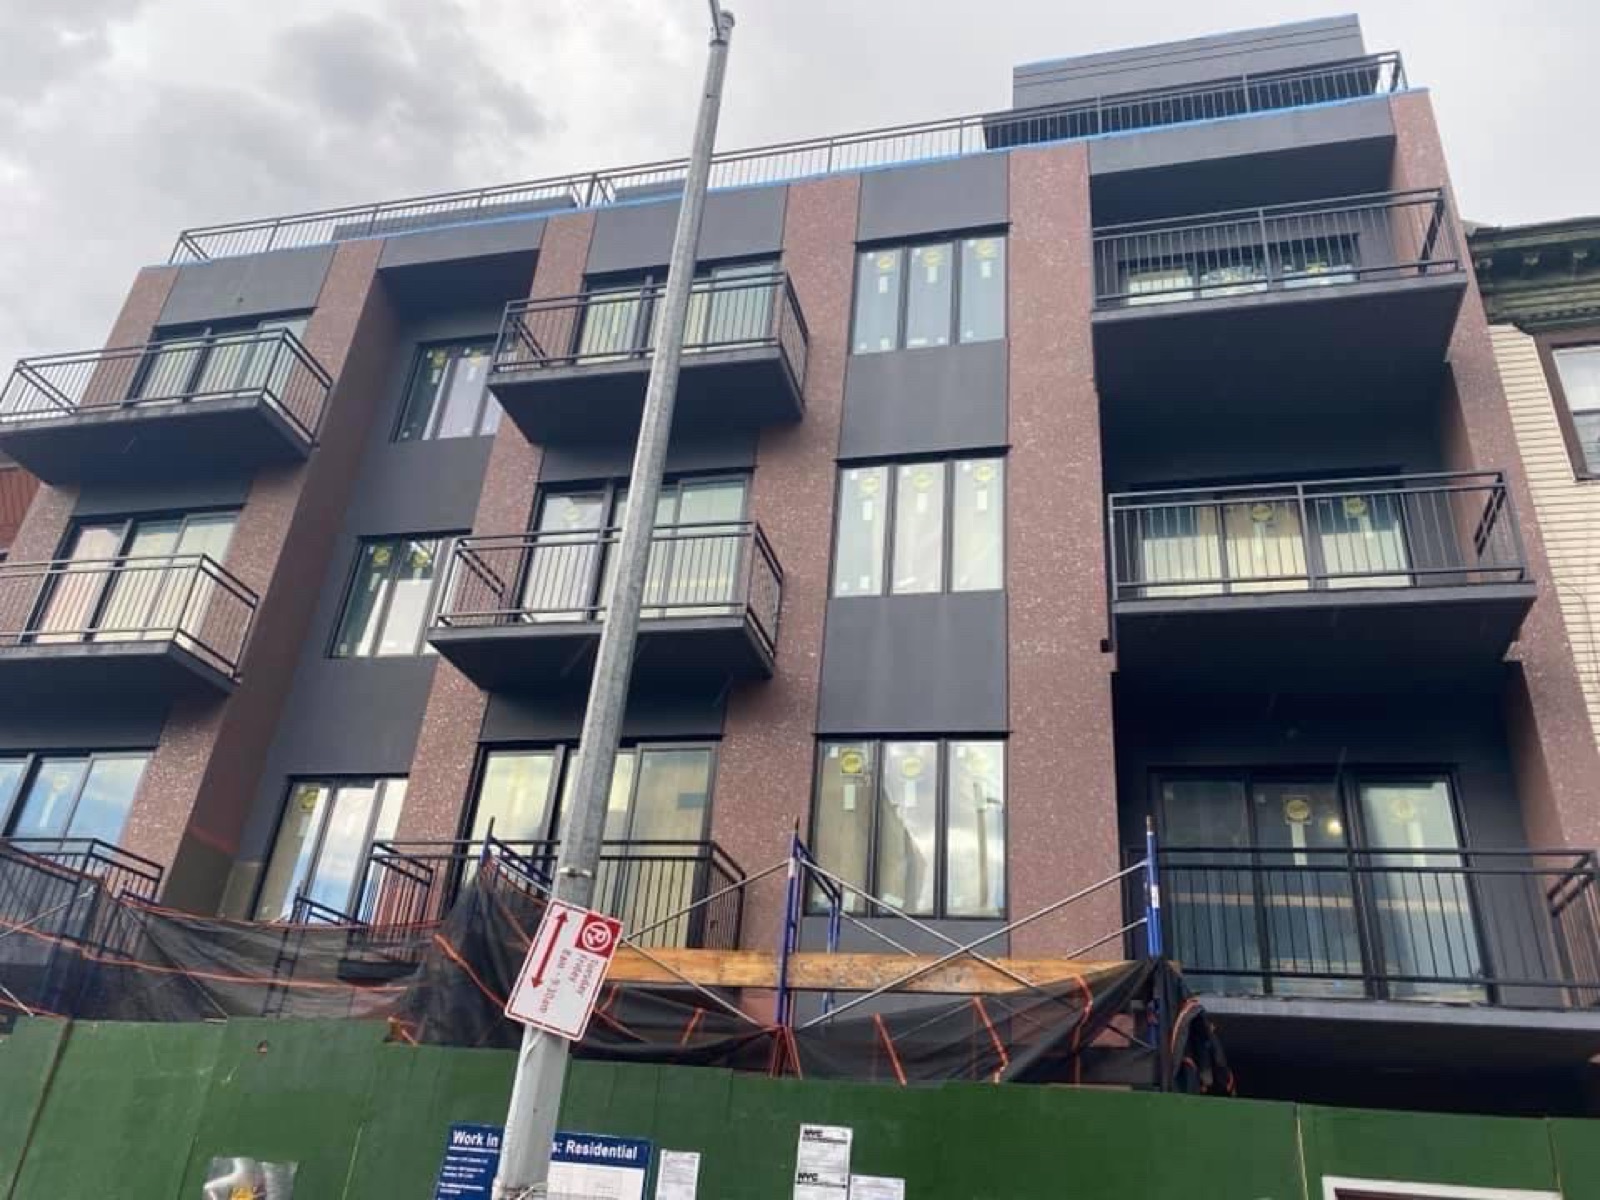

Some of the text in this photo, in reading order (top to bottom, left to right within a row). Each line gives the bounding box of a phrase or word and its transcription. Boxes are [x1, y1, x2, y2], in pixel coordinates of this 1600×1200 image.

[453, 1129, 483, 1146] Work
[566, 1139, 638, 1160] Residential
[798, 1172, 818, 1182] NYC
